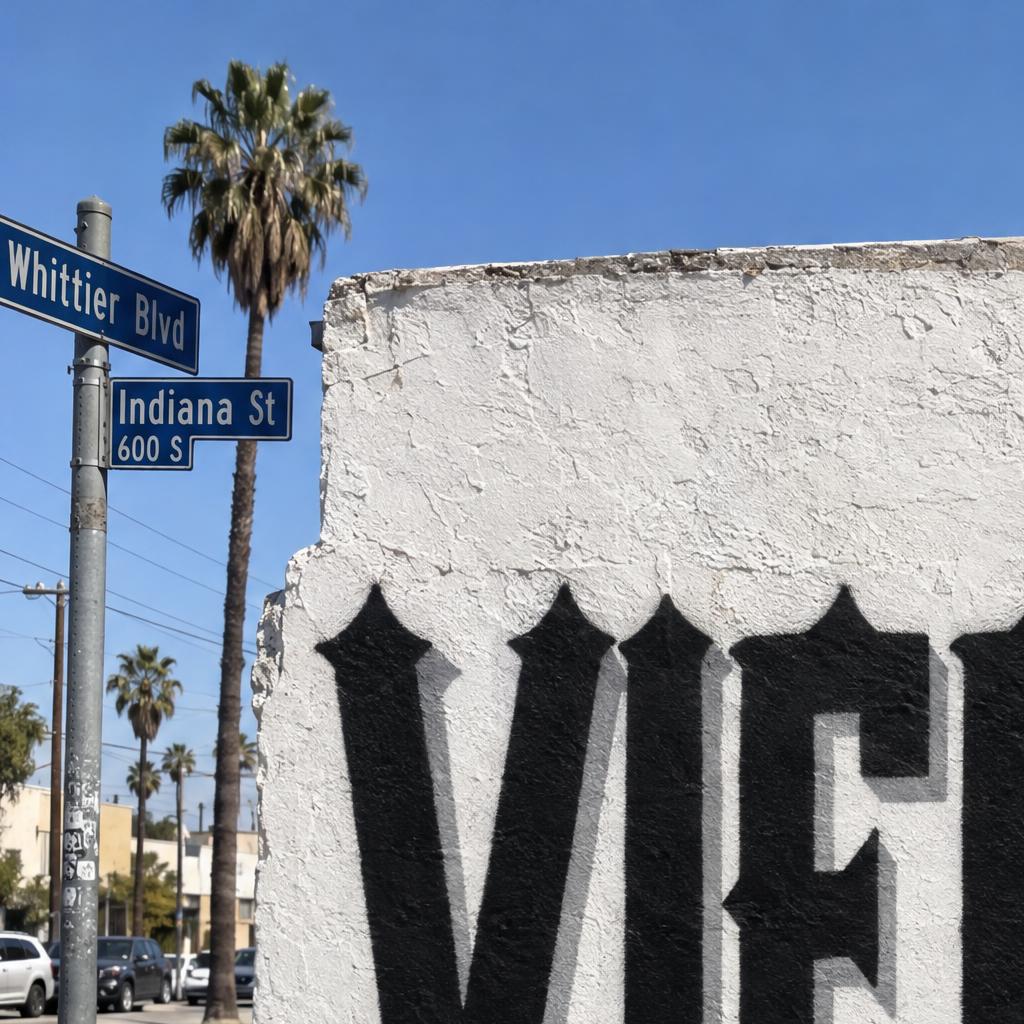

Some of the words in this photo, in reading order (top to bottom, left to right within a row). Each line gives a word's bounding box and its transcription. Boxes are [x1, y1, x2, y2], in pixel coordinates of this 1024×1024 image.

[8, 239, 120, 324] Whittier
[135, 292, 184, 351] Blvd
[119, 388, 233, 425] Indiana
[248, 389, 276, 426] St
[117, 435, 160, 462] 600
[169, 435, 183, 462] S
